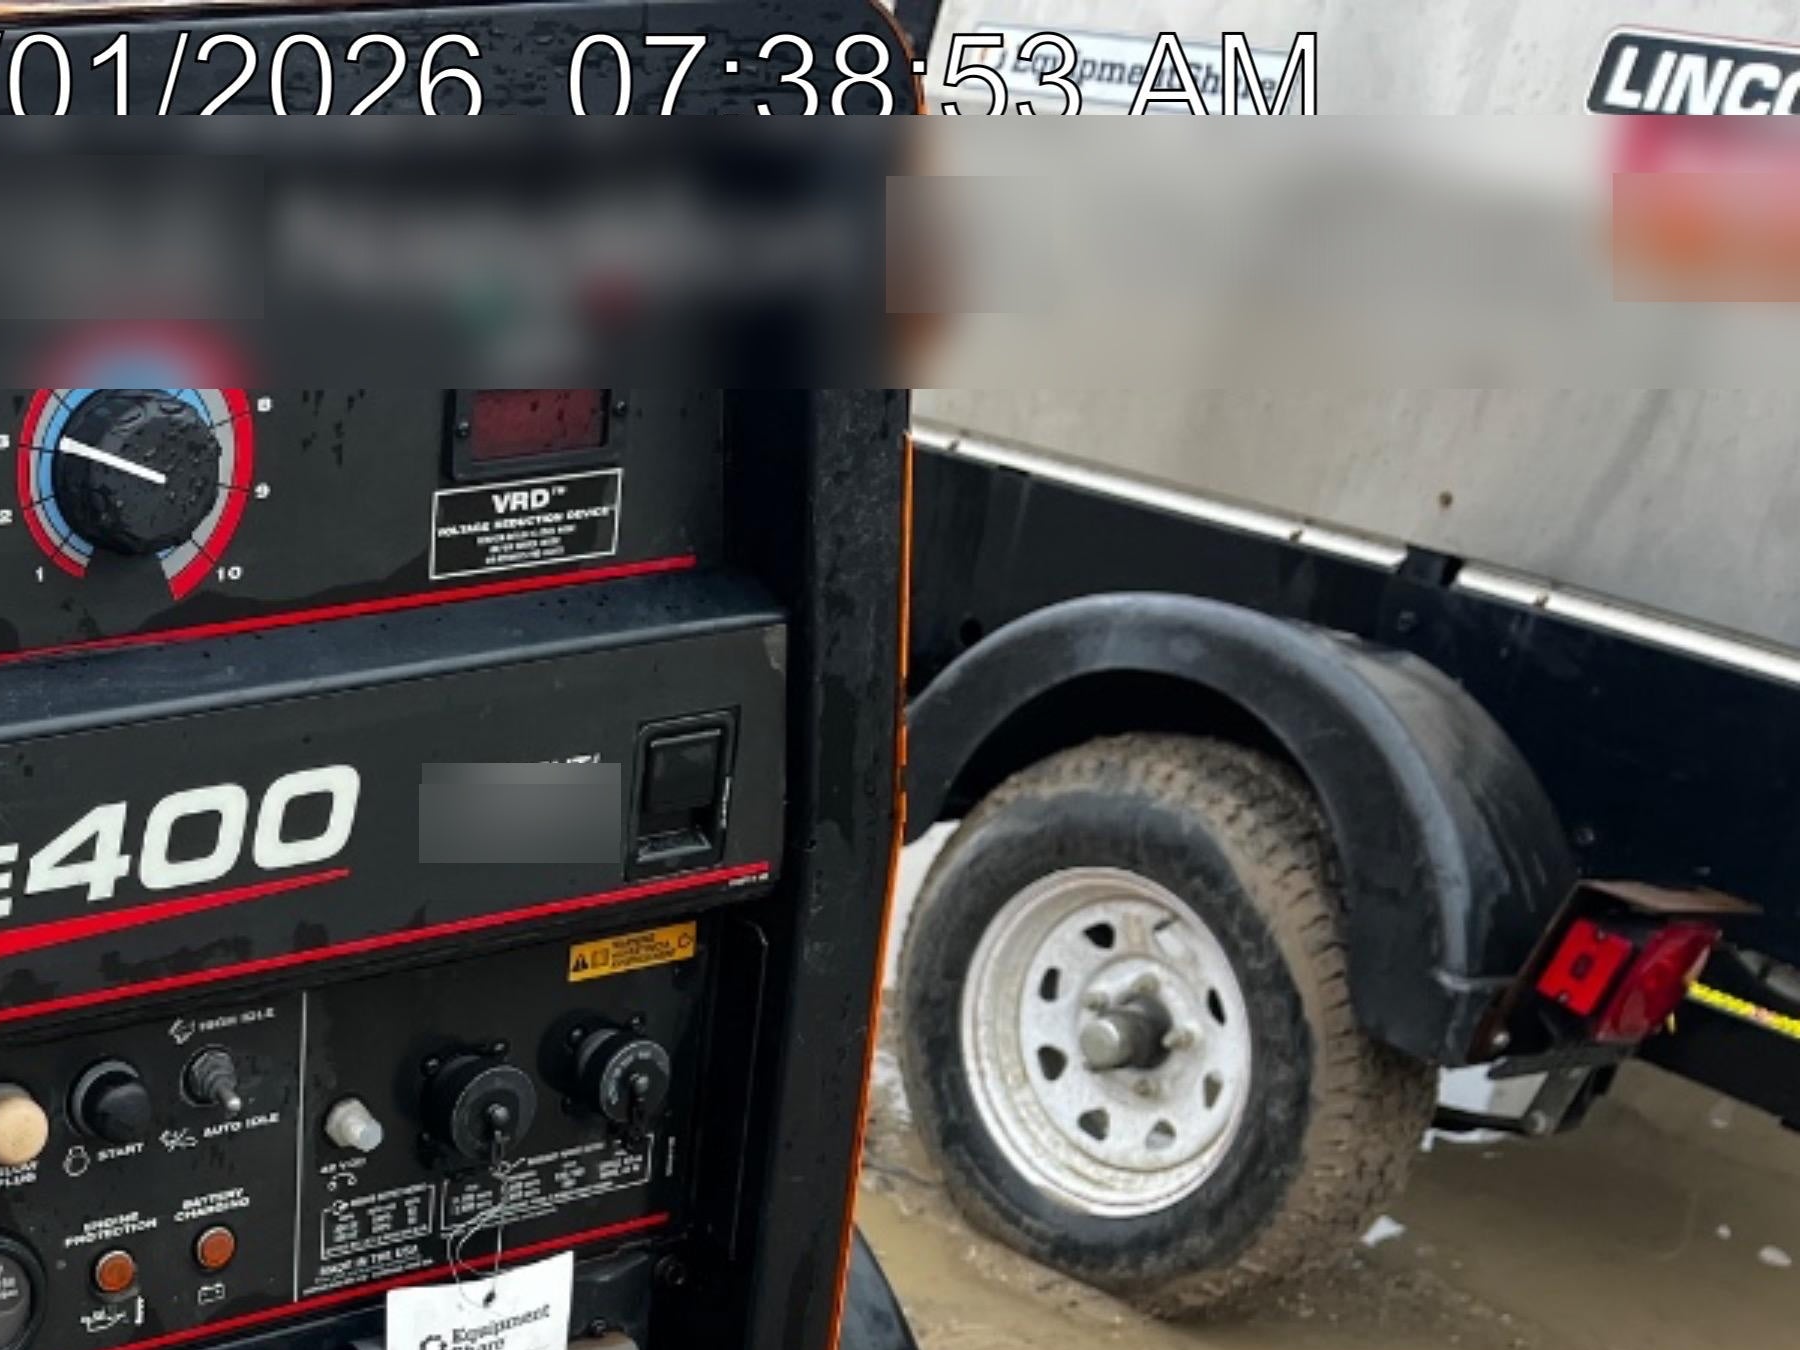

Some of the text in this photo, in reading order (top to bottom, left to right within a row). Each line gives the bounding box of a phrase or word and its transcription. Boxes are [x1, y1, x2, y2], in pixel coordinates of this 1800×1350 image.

[255, 483, 270, 499] 9
[567, 505, 610, 520] DEVICE
[34, 567, 44, 583] 1
[216, 566, 243, 582] 10
[452, 1303, 550, 1345] Equipment
